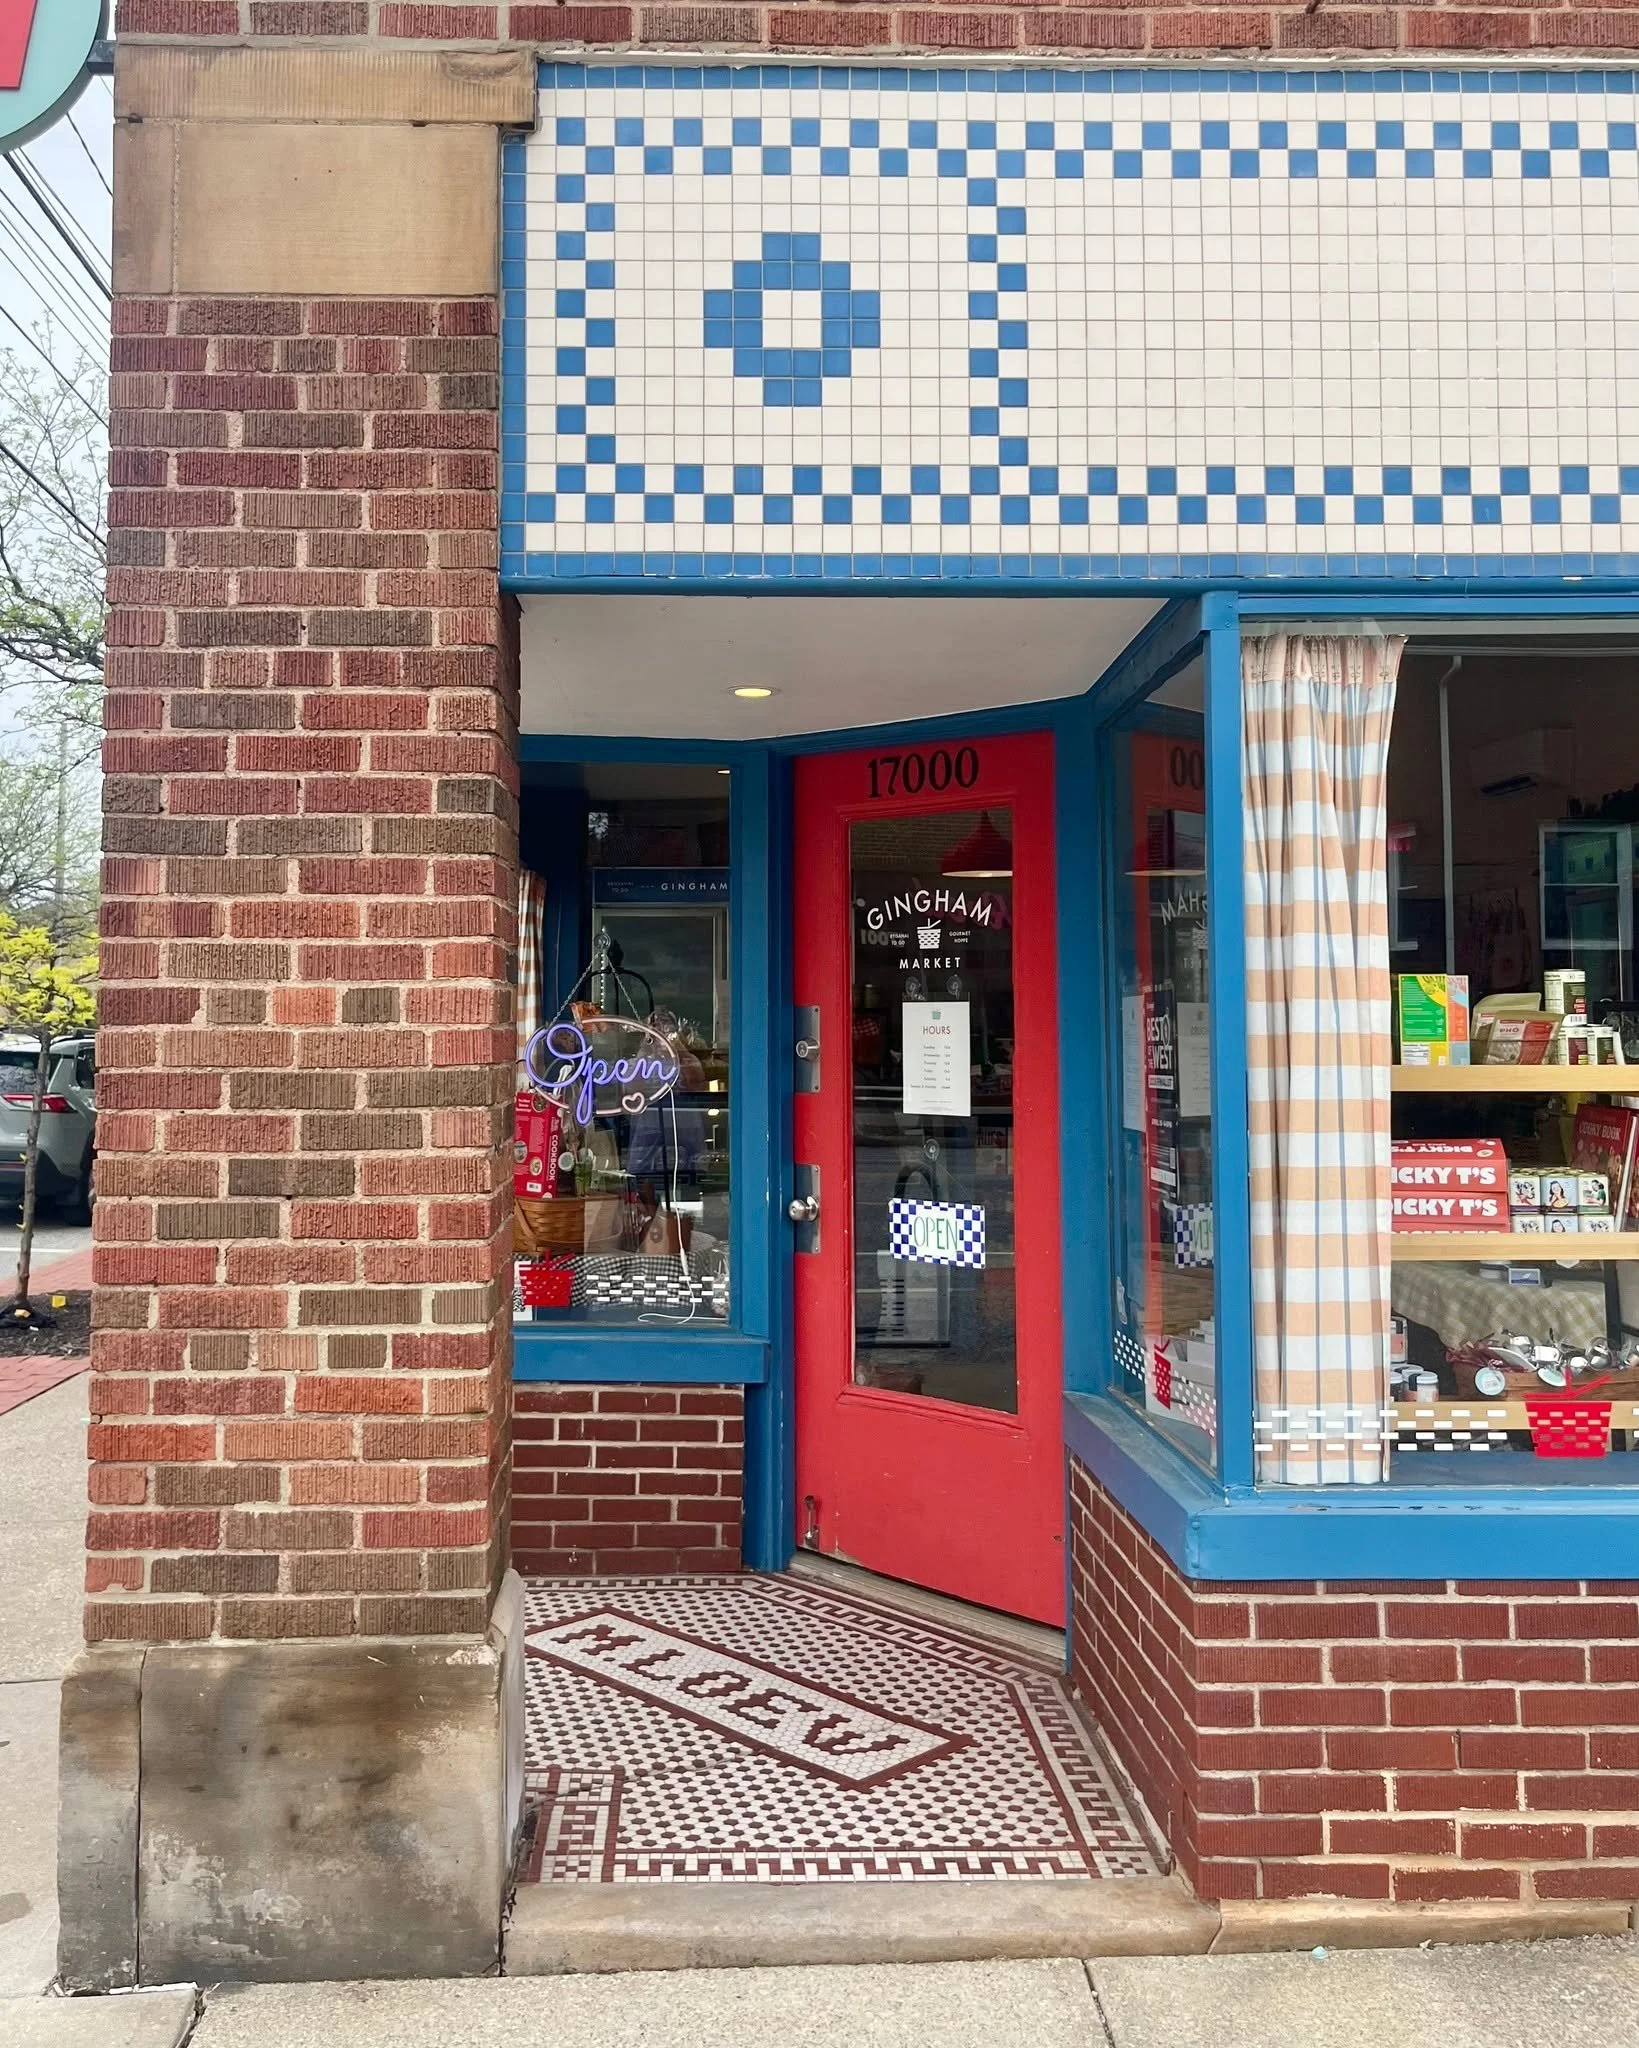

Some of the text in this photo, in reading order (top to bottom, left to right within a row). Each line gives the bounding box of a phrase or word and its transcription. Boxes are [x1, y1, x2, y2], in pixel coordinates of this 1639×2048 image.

[866, 746, 980, 798] 17000
[661, 882, 728, 891] GINGHAM
[867, 889, 992, 930] GINGHAM
[899, 957, 961, 969] MARKET
[922, 1025, 951, 1035] HOURS
[525, 1023, 677, 1126] Open
[1391, 1166, 1497, 1185] ICKY T'S
[1391, 1198, 1499, 1217] ICKY T'S
[913, 1217, 958, 1251] OPEN
